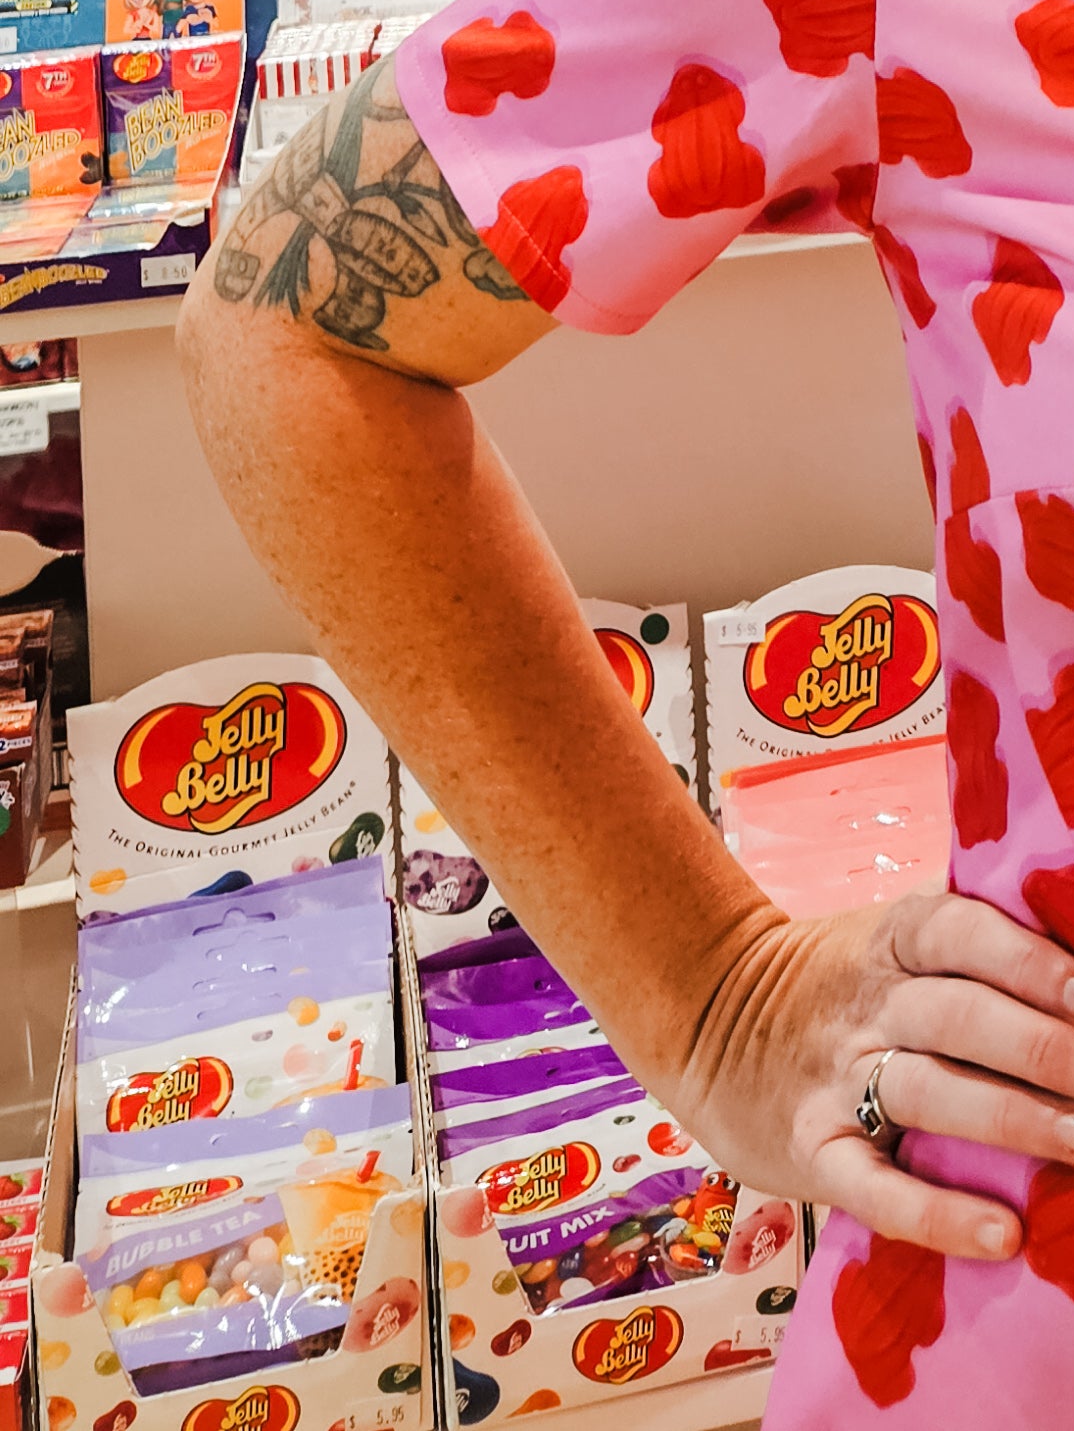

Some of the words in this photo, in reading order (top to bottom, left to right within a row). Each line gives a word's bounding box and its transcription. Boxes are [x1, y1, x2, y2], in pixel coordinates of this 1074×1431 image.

[0, 108, 36, 148] AN
[126, 87, 183, 144] BEAN
[0, 129, 81, 181] OOZLED
[131, 110, 227, 174] BOOZLED
[810, 595, 893, 668] Jelly
[192, 683, 285, 763] Jelly
[783, 666, 880, 737] Belly
[736, 727, 755, 747] THE
[889, 724, 918, 744] JELLY
[162, 760, 270, 832] Belly
[108, 828, 129, 848] THE
[136, 841, 201, 859] ORIGINAL
[209, 832, 277, 857] GOURMET
[284, 815, 317, 839] JELLY
[147, 1058, 199, 1103] Jelly
[129, 1099, 190, 1132] Belly
[515, 1145, 566, 1186] Jelly
[151, 1179, 208, 1202] Jelly
[499, 1178, 560, 1211] Belly
[105, 1228, 203, 1279] BUBBLE
[210, 1211, 262, 1235] TEA
[503, 1228, 551, 1253] UIT
[560, 1206, 616, 1238] MIX
[610, 1306, 654, 1349] Jelly
[735, 1329, 742, 1344] $
[595, 1345, 648, 1384] Belly
[221, 1385, 269, 1430] Jelly
[349, 1415, 356, 1429] $
[376, 1405, 405, 1426] 5.95
